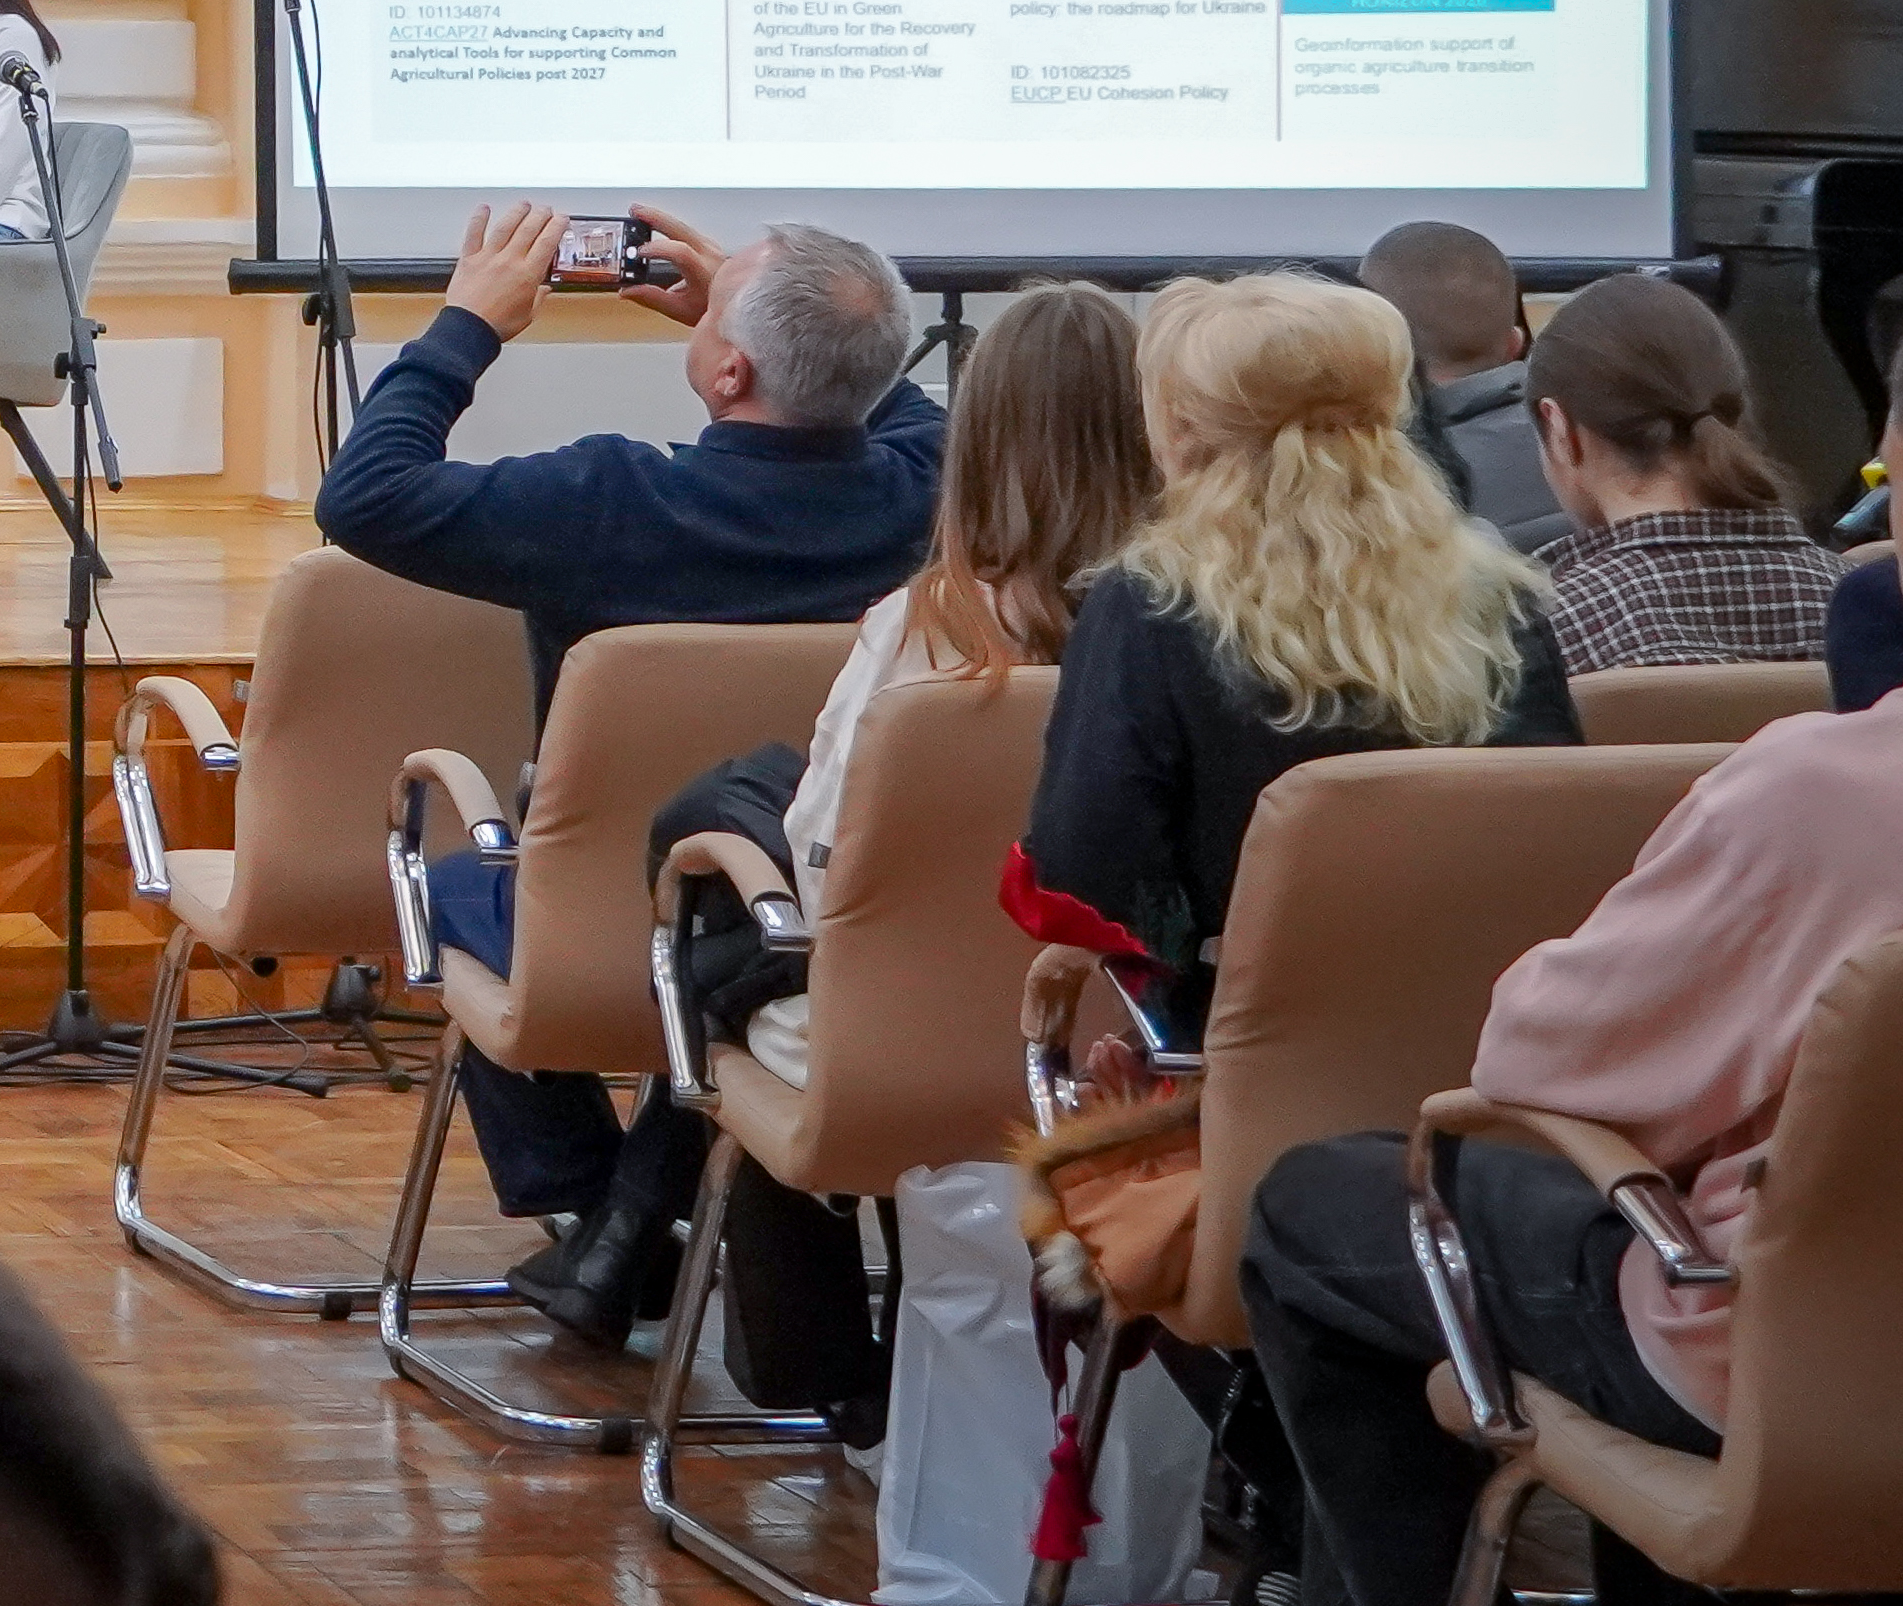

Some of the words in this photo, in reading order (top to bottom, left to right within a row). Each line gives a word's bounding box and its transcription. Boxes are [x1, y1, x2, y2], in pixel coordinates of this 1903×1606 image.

[419, 5, 500, 19] 101134874
[754, 2, 770, 15] of
[774, 2, 799, 15] the
[804, 1, 828, 15] EU
[834, 4, 847, 14] in
[853, 2, 902, 15] Green
[1067, 2, 1093, 15] the
[1098, 2, 1170, 17] roadmap
[1175, 0, 1197, 14] for
[1202, 0, 1267, 14] Ukraine
[493, 26, 567, 41] Advancing
[572, 26, 633, 40] Capacity
[638, 26, 664, 38] and
[753, 22, 839, 38] Agriculture
[845, 23, 865, 36] for
[870, 22, 896, 35] the
[900, 21, 976, 36] Recovery
[754, 43, 784, 57] and
[789, 43, 908, 57] Transformation
[913, 43, 928, 56] of
[1498, 36, 1515, 51] of
[390, 46, 458, 61] analytical
[463, 46, 499, 58] Tools
[504, 46, 524, 58] for
[529, 47, 606, 61] supporting
[611, 47, 676, 58] Common
[390, 67, 473, 83] Agricultural
[478, 67, 531, 80] Policies
[536, 70, 567, 82] post
[572, 68, 605, 80] 2027
[755, 65, 816, 79] Ukraine
[821, 66, 834, 78] in
[840, 66, 864, 78] the
[1362, 60, 1450, 77] agriculture
[1457, 60, 1534, 73] transition
[755, 85, 806, 99] Period
[1011, 86, 1062, 101] EUCP
[1063, 86, 1092, 103] EU
[1097, 86, 1175, 100] Cohesion
[1179, 85, 1229, 102] Policy
